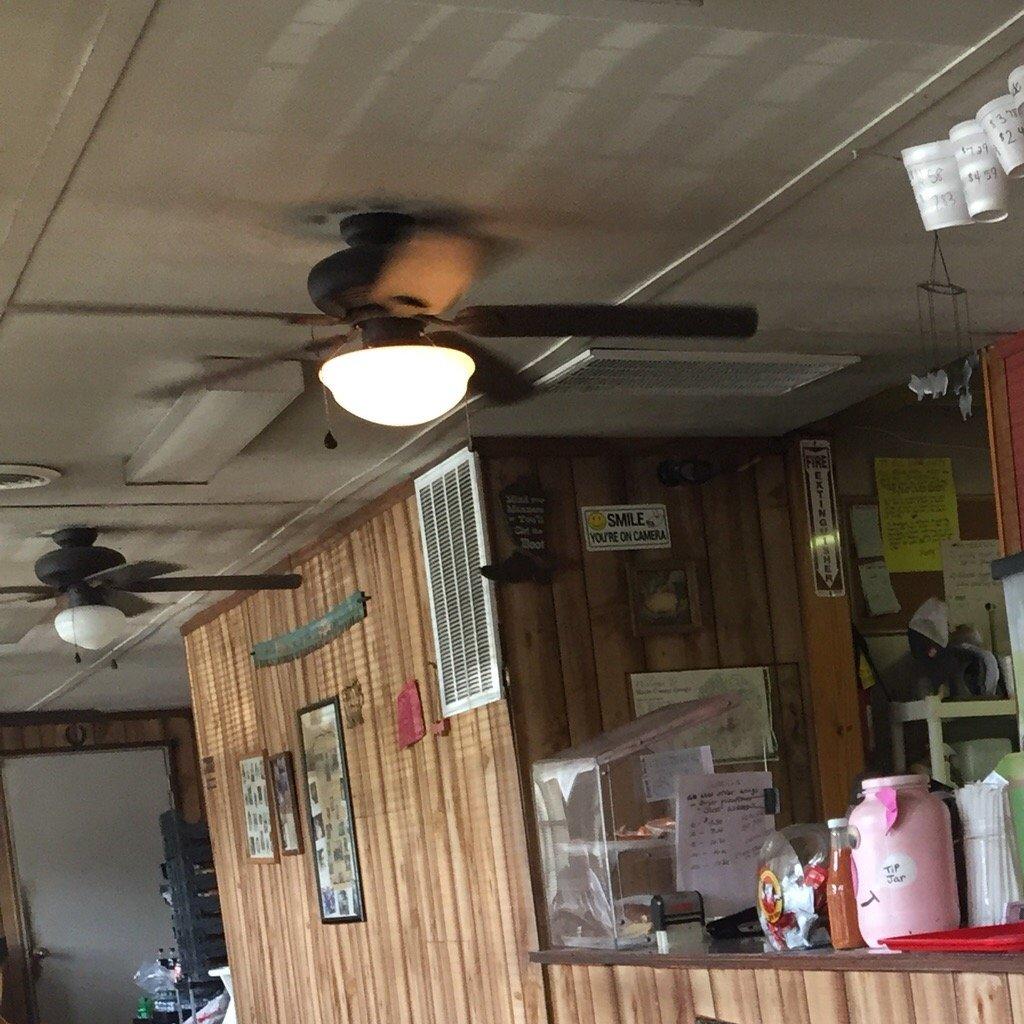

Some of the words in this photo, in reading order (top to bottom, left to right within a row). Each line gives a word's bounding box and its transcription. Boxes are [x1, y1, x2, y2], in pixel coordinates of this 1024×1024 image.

[607, 512, 645, 527] SMILE
[591, 531, 618, 543] YOU'RE
[620, 531, 632, 542] ON
[633, 529, 667, 542] CAMERA
